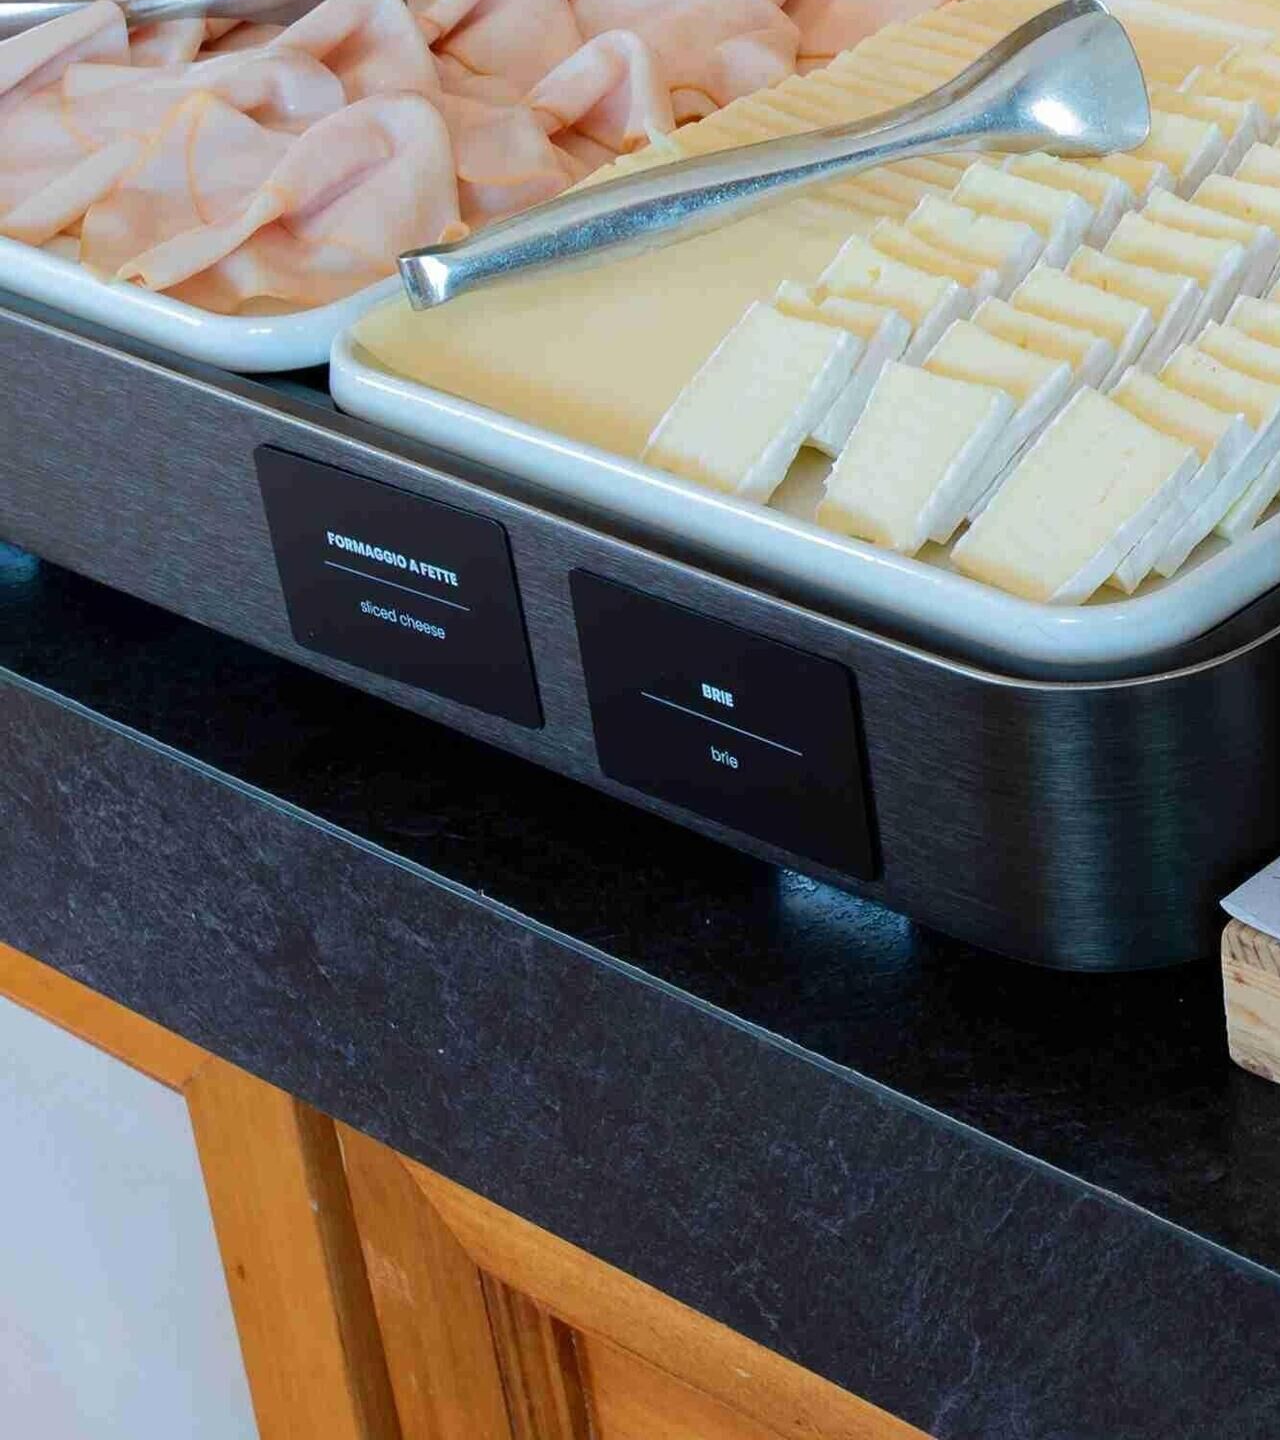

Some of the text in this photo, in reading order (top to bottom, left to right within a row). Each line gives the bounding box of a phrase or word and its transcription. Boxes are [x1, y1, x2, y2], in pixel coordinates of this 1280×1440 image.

[327, 531, 459, 587] FORMAGGIO A FETTE
[360, 599, 446, 639] sliced cheese
[702, 683, 734, 708] BRIE
[710, 746, 739, 769] brie
